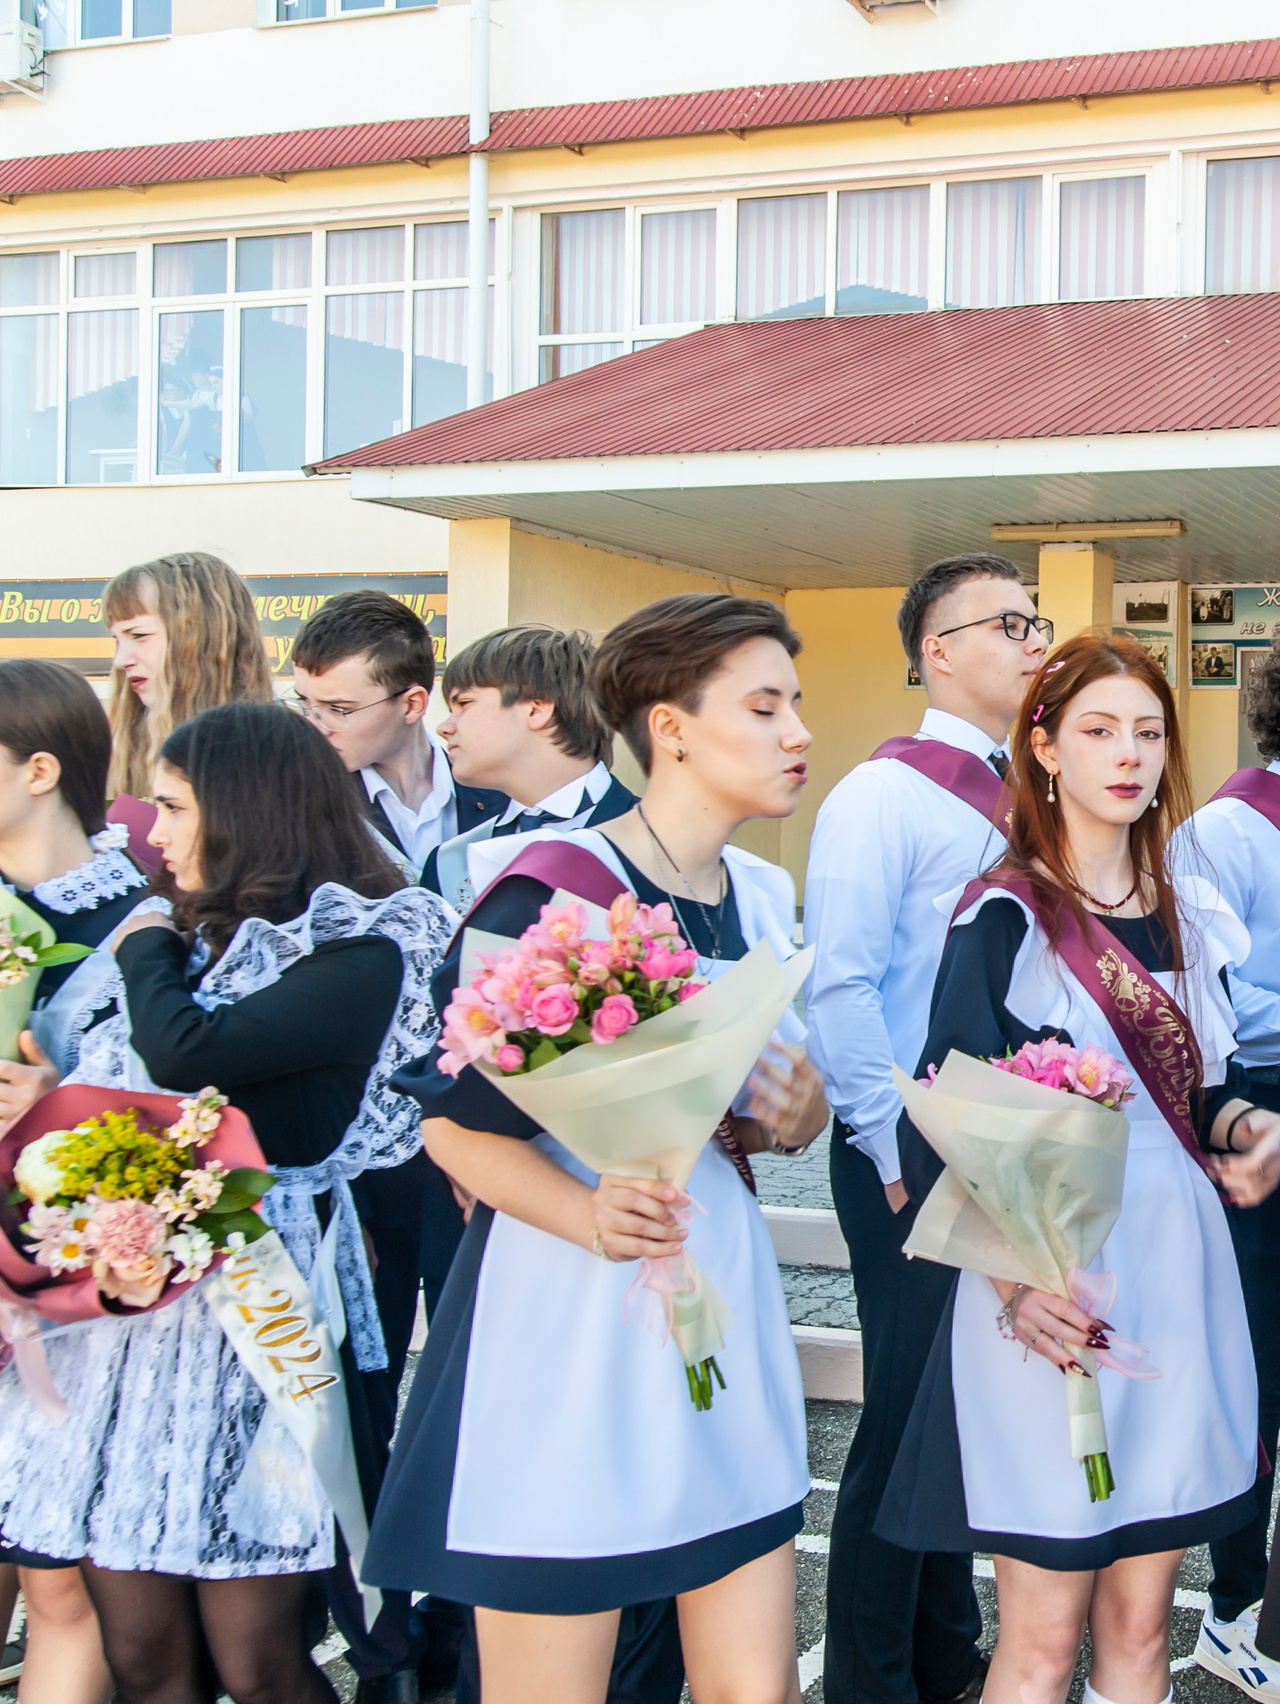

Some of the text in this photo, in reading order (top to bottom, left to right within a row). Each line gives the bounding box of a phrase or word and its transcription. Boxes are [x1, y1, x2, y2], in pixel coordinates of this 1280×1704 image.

[0, 591, 52, 624] Вы
[1240, 621, 1267, 635] не
[236, 1288, 339, 1406] 2024
[1239, 1642, 1257, 1662] Reebok
